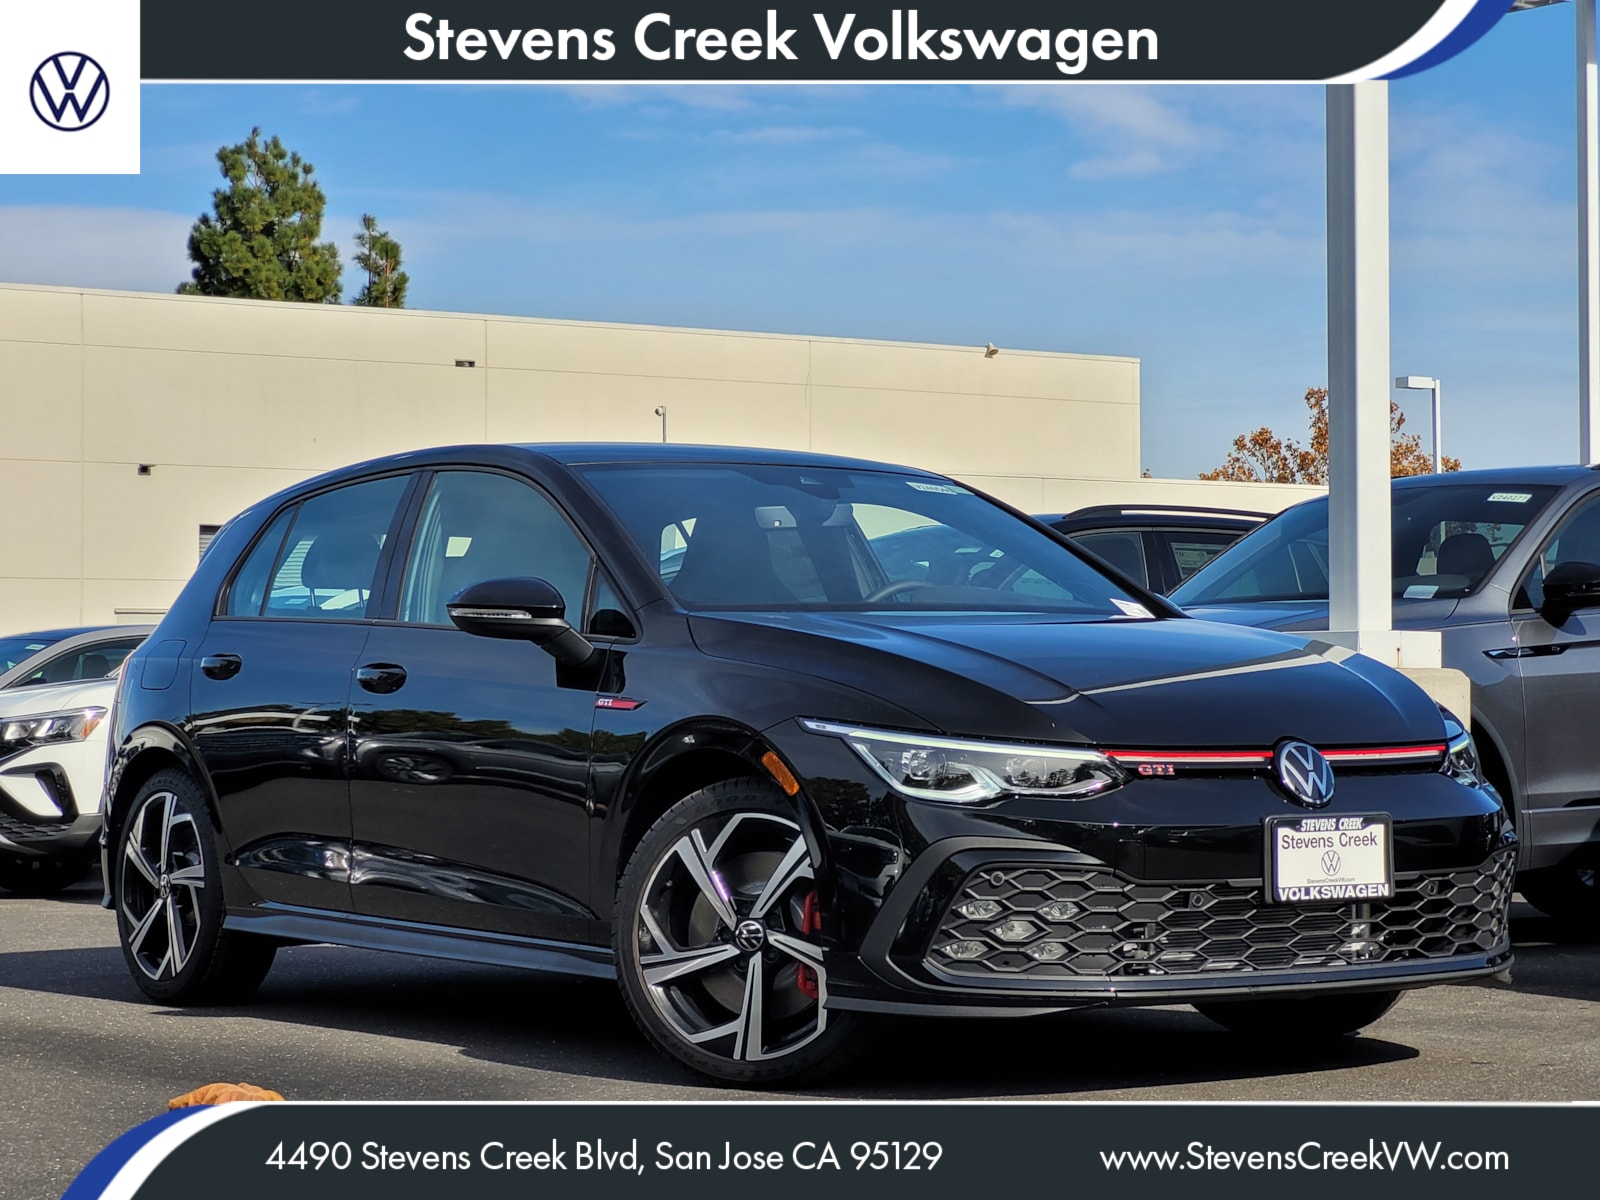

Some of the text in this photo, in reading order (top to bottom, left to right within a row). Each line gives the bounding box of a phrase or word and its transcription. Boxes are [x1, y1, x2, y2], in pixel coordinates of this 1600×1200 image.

[598, 698, 613, 706] GTI
[1138, 763, 1175, 776] GTI
[1300, 817, 1364, 832] STEVENS CREEK
[1281, 832, 1378, 850] Stevens Creek
[1278, 884, 1390, 901] VOLKSWAGEN
